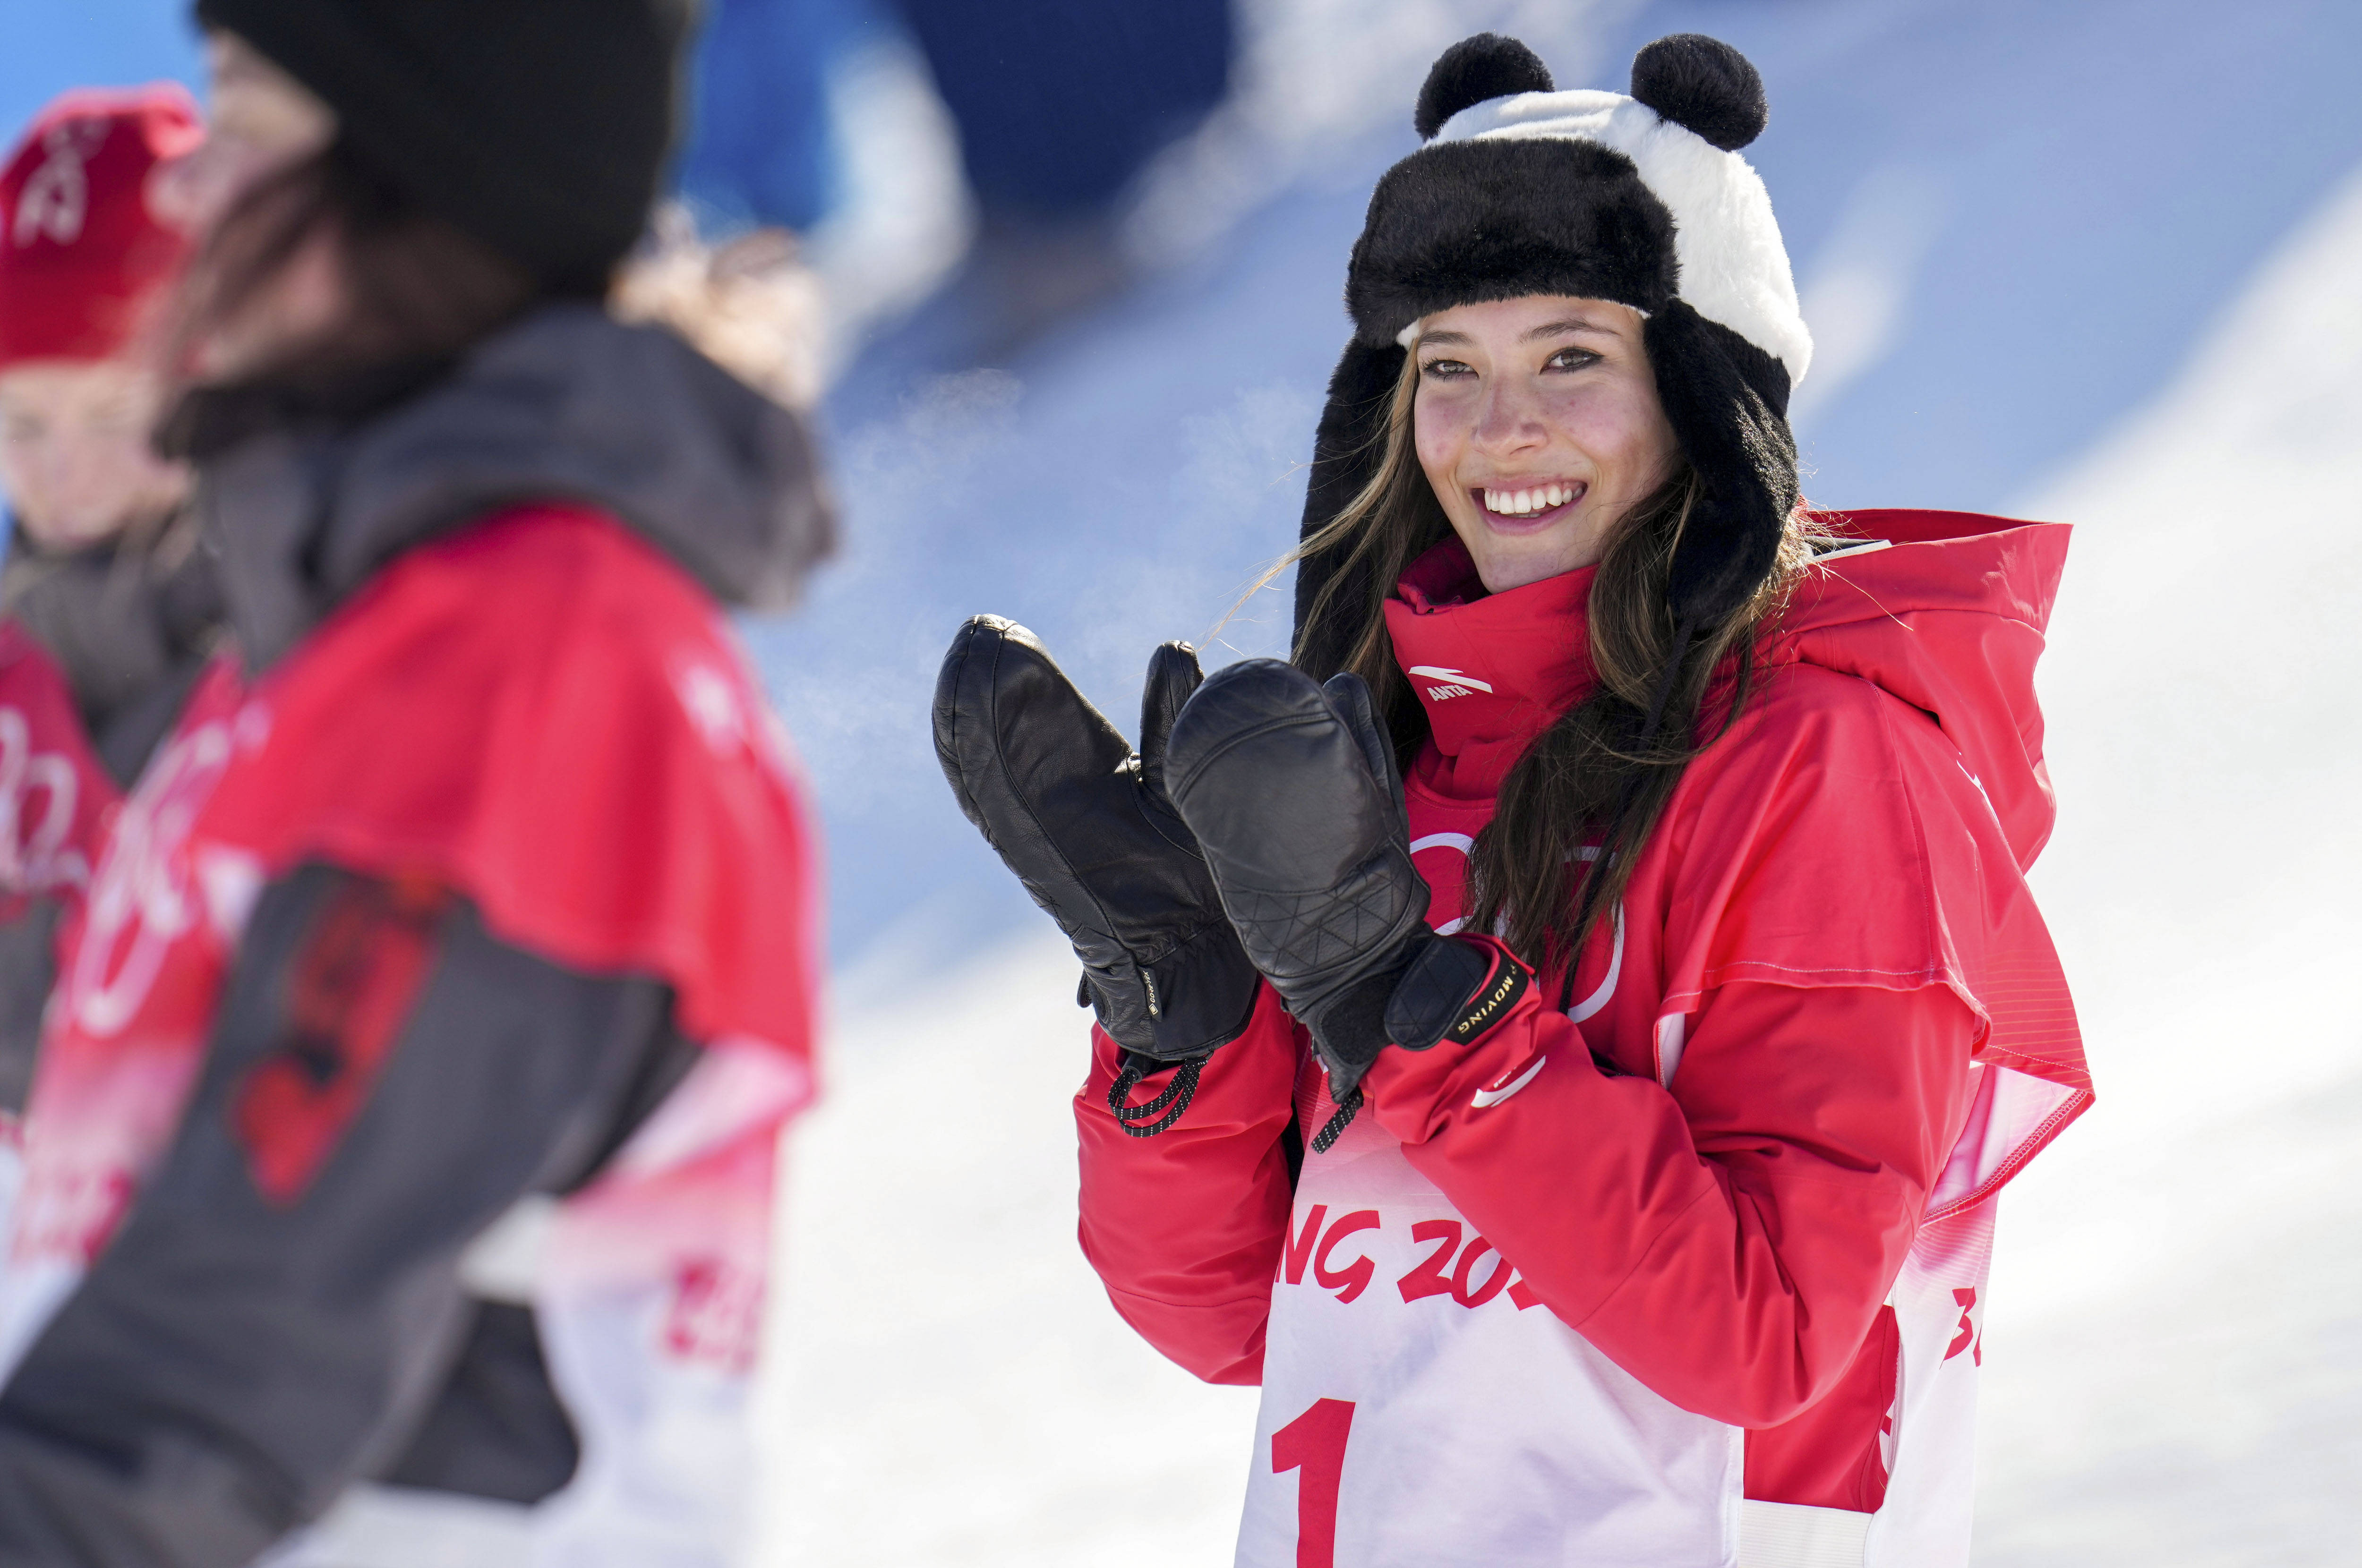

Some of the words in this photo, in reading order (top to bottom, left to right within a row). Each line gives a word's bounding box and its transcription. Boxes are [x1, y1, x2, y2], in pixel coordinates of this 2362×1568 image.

[1427, 685, 1473, 702] ANTA
[1458, 976, 1514, 1034] MOVING
[1396, 1219, 1545, 1312] 20
[1271, 1398, 1356, 1568] 1
